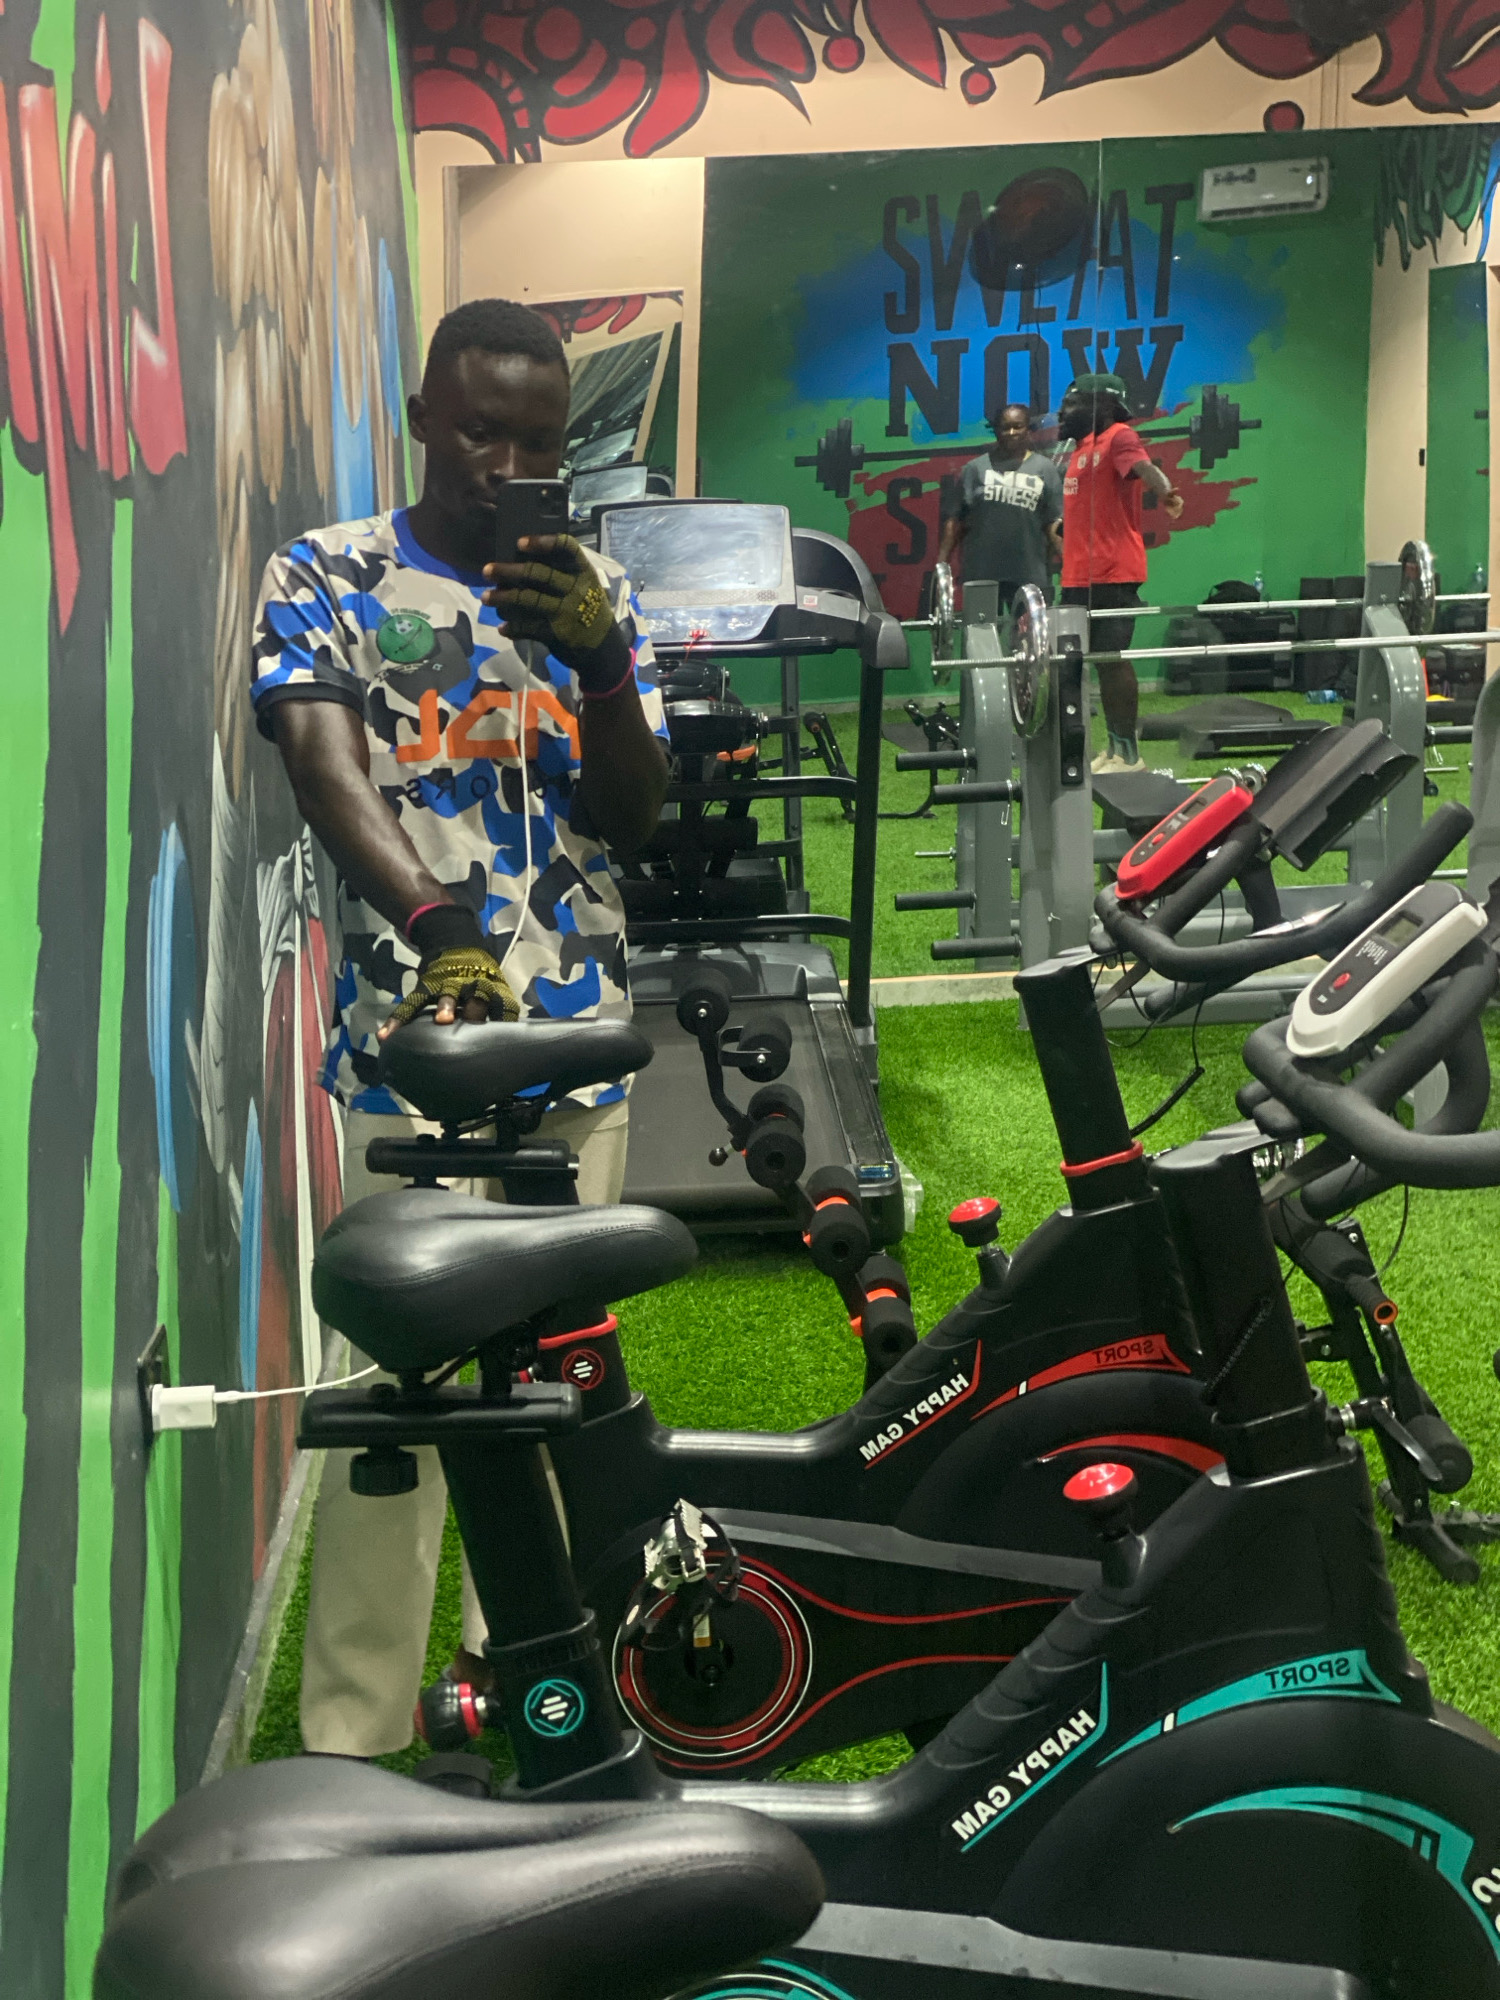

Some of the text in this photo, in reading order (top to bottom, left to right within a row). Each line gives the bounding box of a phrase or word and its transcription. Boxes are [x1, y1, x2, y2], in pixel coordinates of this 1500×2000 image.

[884, 324, 1184, 437] NOW
[984, 469, 1045, 495] NO
[983, 484, 1040, 512] STRESS
